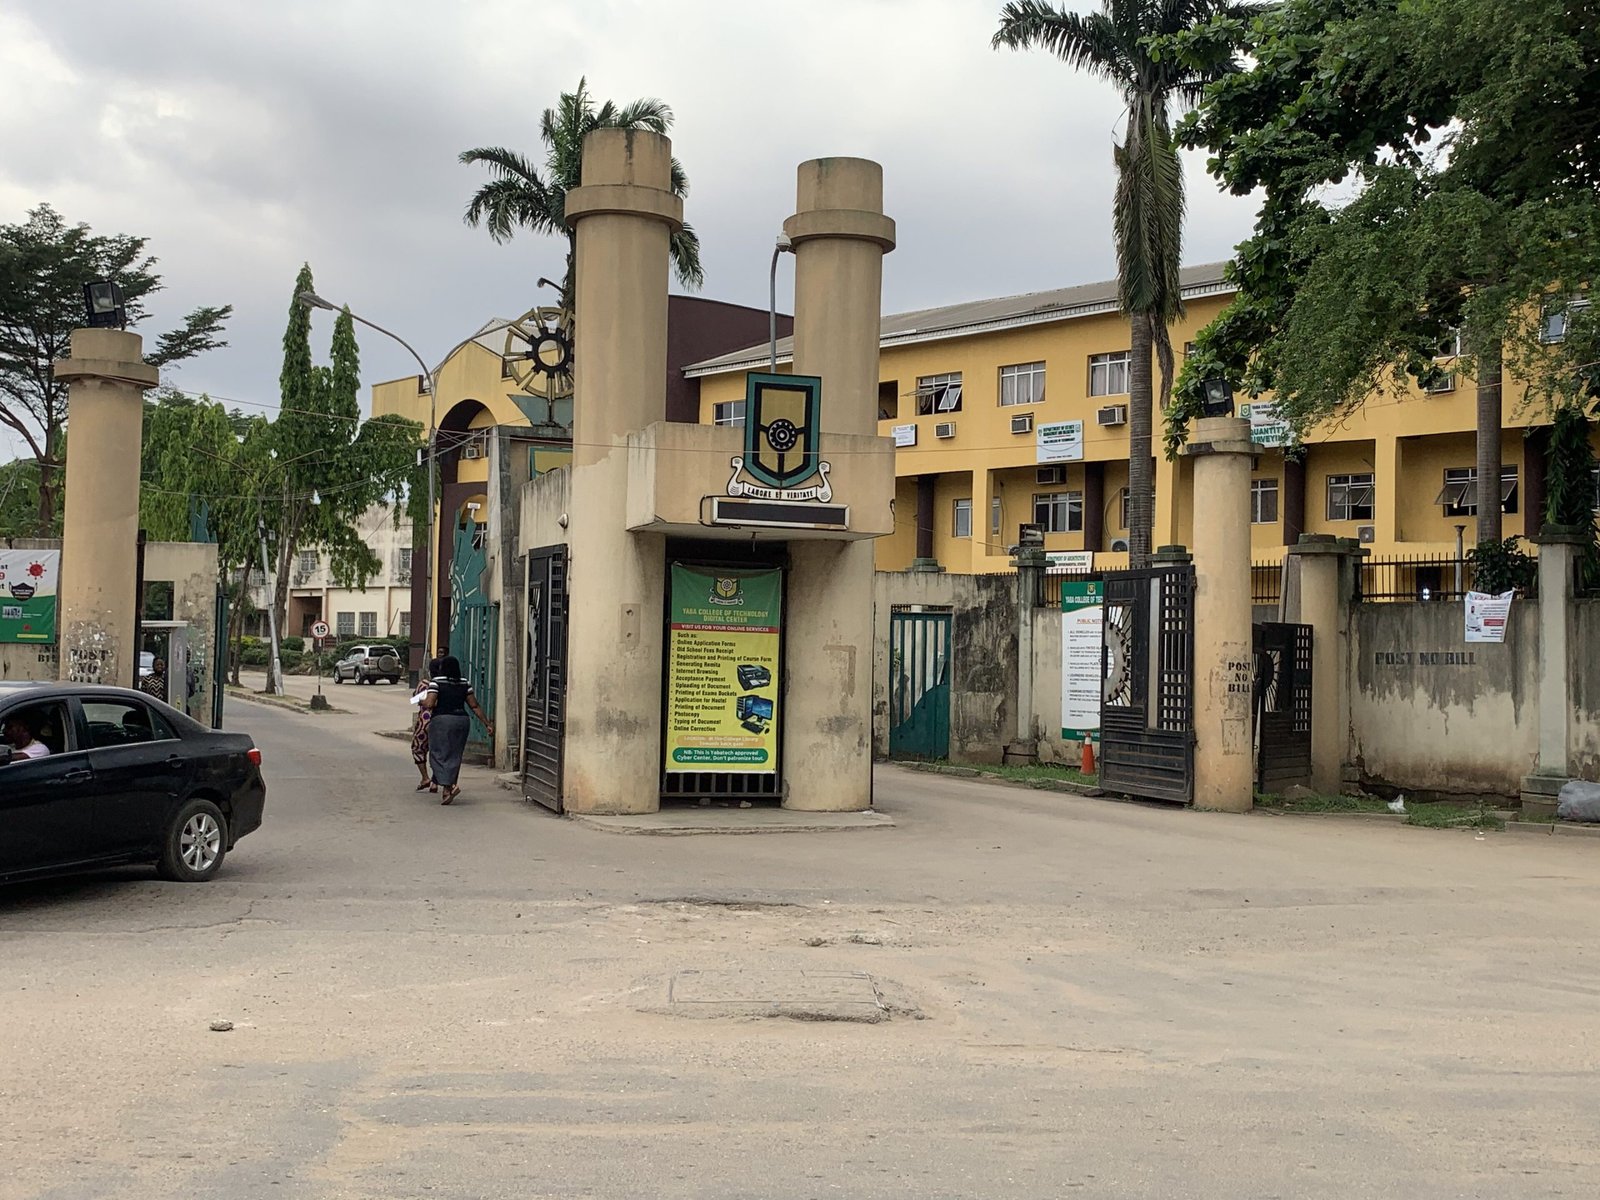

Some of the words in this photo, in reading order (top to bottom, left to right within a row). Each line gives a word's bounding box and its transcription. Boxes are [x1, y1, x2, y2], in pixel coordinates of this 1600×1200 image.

[748, 487, 771, 497] LABORE
[1375, 652, 1413, 665] POST
[1420, 652, 1439, 665] NO
[1446, 652, 1476, 665] BILL
[1228, 662, 1250, 671] POST
[1235, 673, 1247, 682] NO
[1228, 684, 1250, 692] BILL
